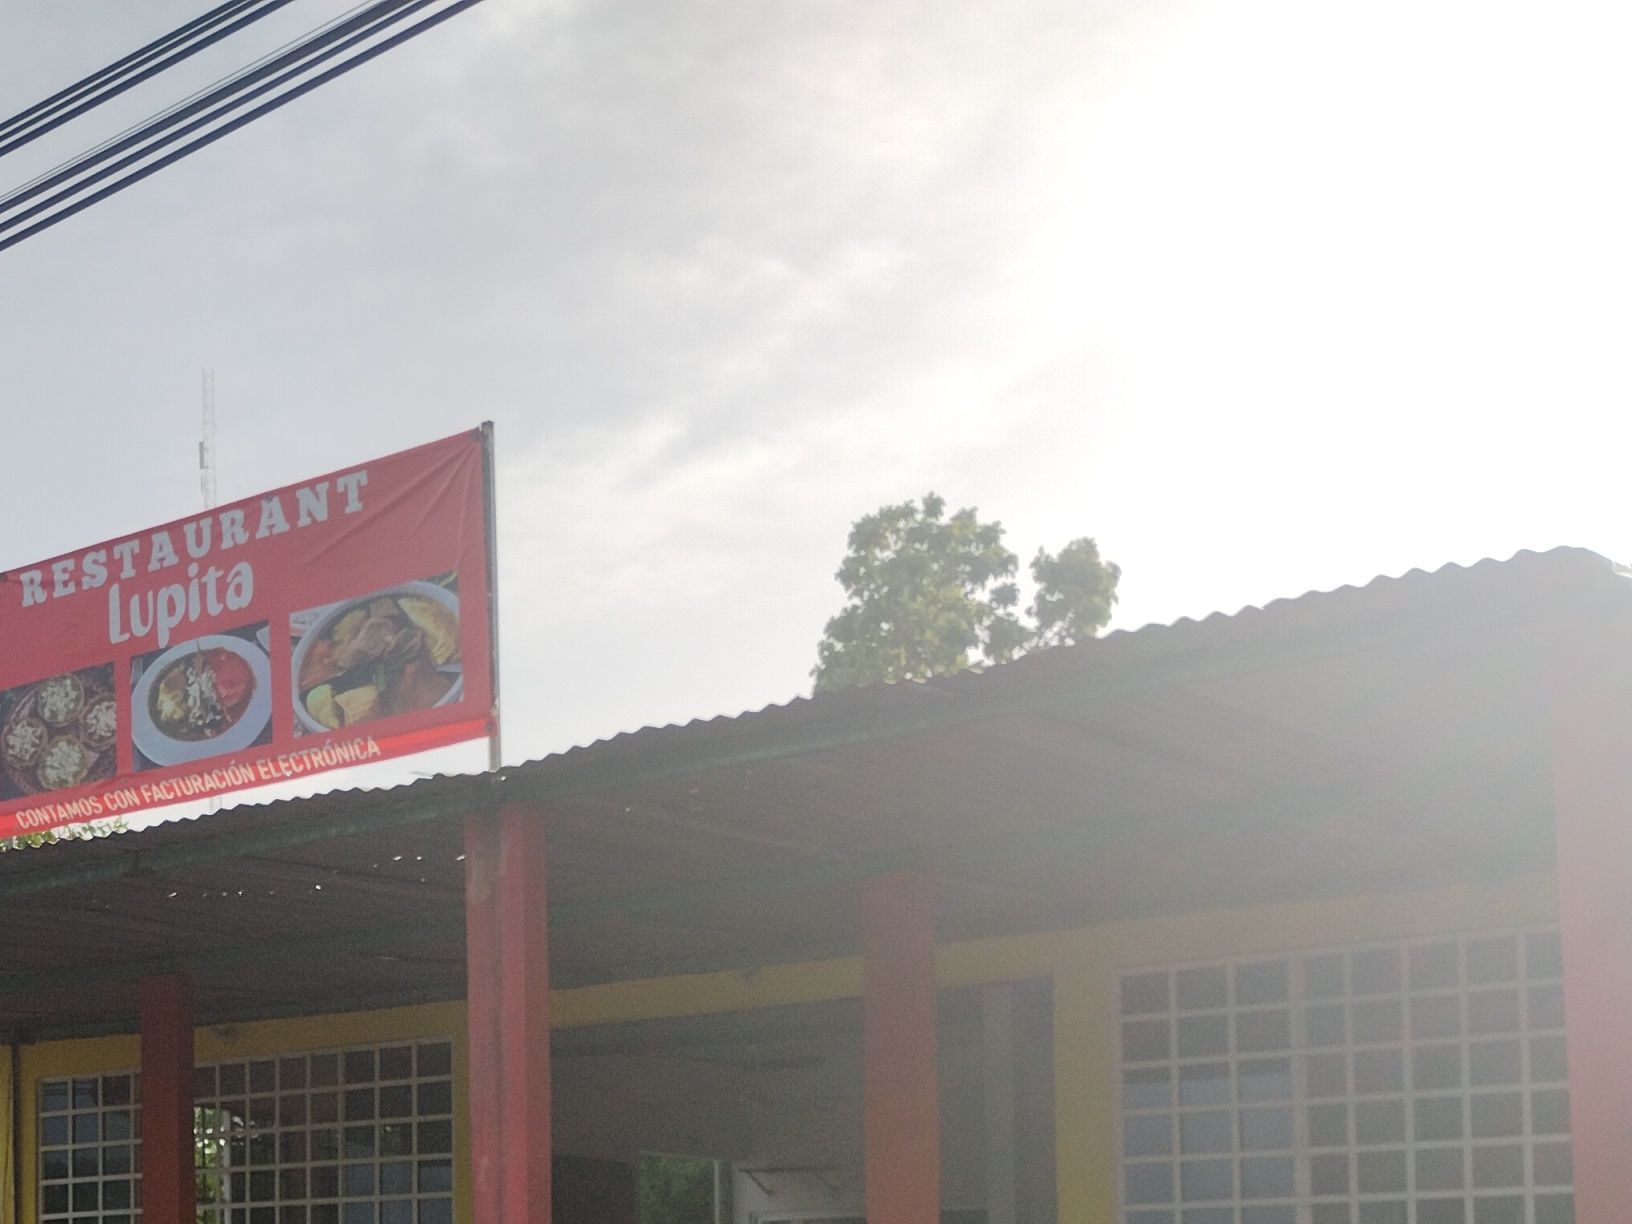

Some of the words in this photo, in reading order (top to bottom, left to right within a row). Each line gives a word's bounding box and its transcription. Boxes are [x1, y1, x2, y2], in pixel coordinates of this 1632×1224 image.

[19, 470, 368, 608] RESTAURANT
[15, 793, 103, 829] CONTAMOS
[104, 784, 138, 811] CON
[141, 759, 256, 803] FACTURACIÓN
[256, 736, 382, 780] ELECTRÓNICA
